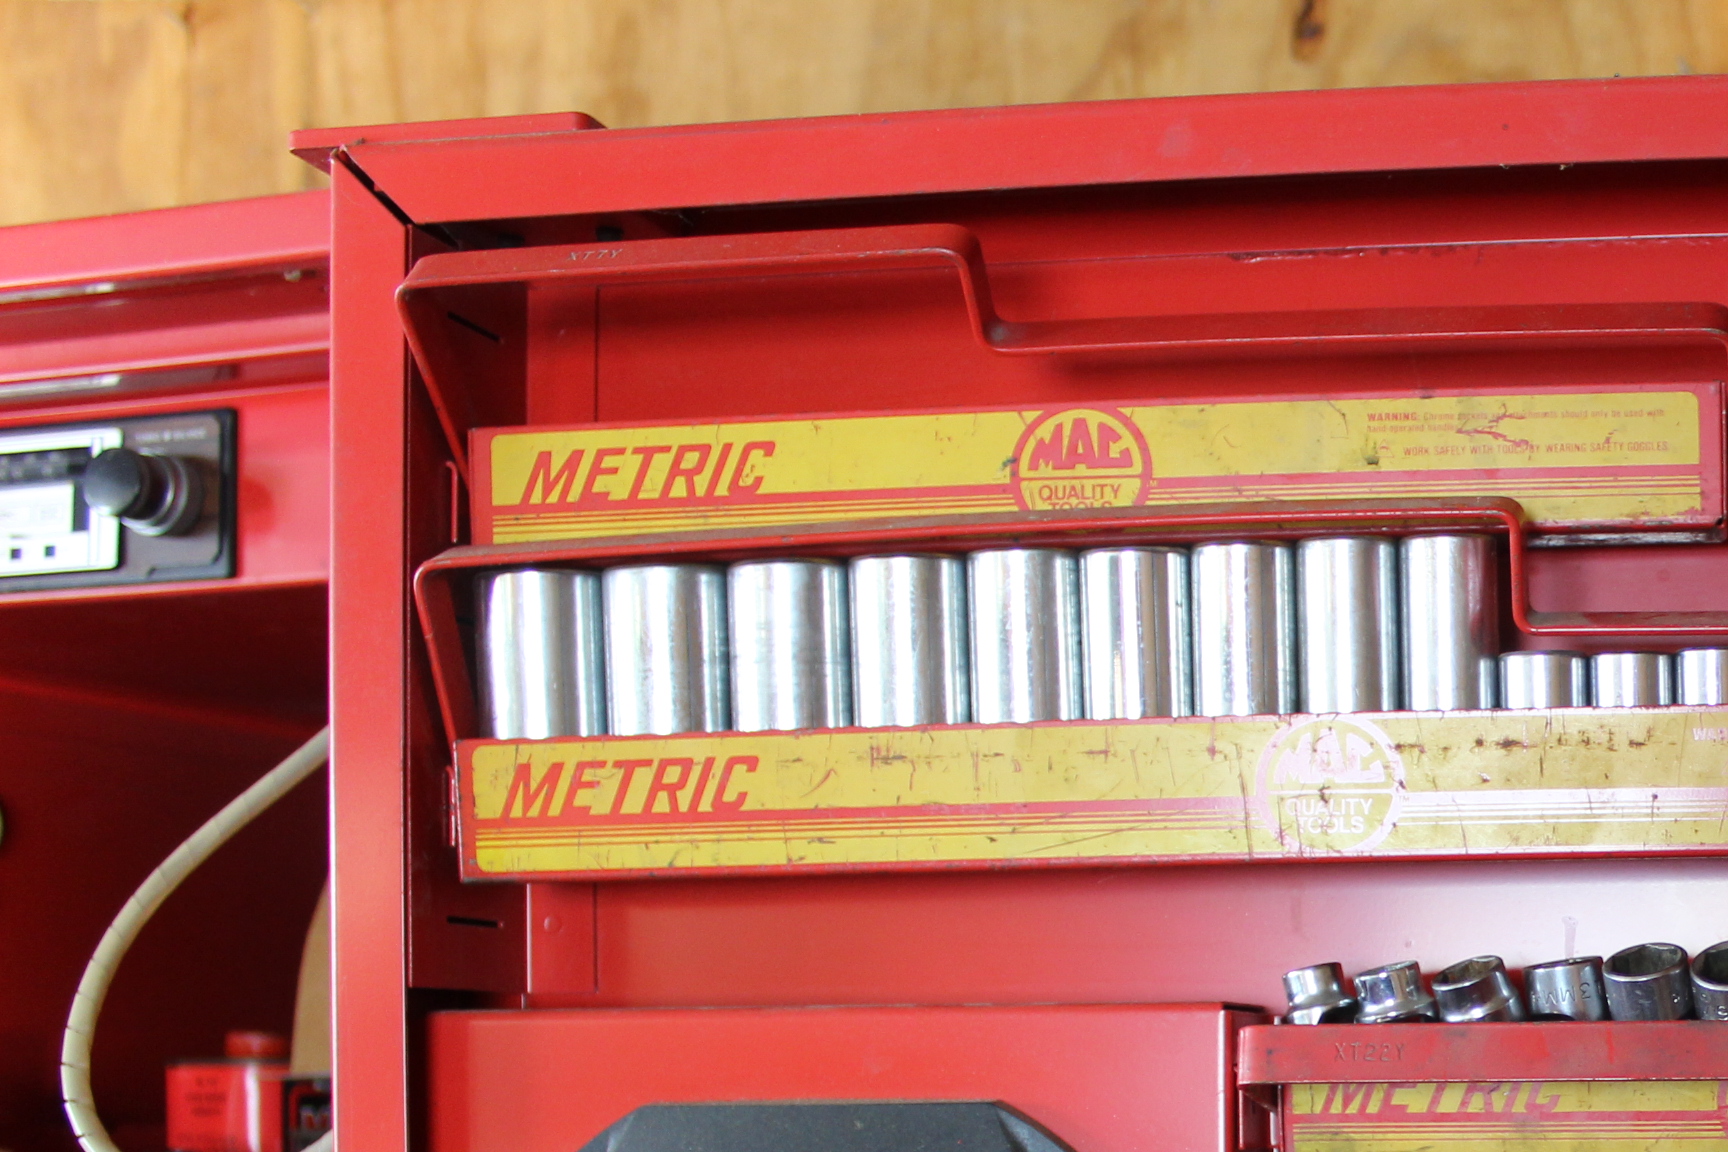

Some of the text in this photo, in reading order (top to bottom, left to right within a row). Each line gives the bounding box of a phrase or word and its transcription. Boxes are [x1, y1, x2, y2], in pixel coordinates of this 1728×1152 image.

[1367, 412, 1420, 422] WARNING:
[1561, 409, 1588, 418] should
[1591, 409, 1608, 420] only
[1611, 408, 1621, 417] be
[1623, 408, 1643, 417] used
[1028, 418, 1133, 471] MAC
[1404, 445, 1430, 456] WORK
[1433, 444, 1465, 456] SAFELY
[1470, 444, 1494, 455] WITH
[1546, 442, 1587, 453] WEARING
[1590, 441, 1624, 452] SAFETY
[519, 441, 776, 504] METRIC
[1039, 484, 1121, 501] QUALITY
[1273, 728, 1385, 784] MAC
[501, 755, 760, 817] METRIC
[1285, 798, 1373, 816] QUALITY
[1297, 816, 1365, 834] TOOLS
